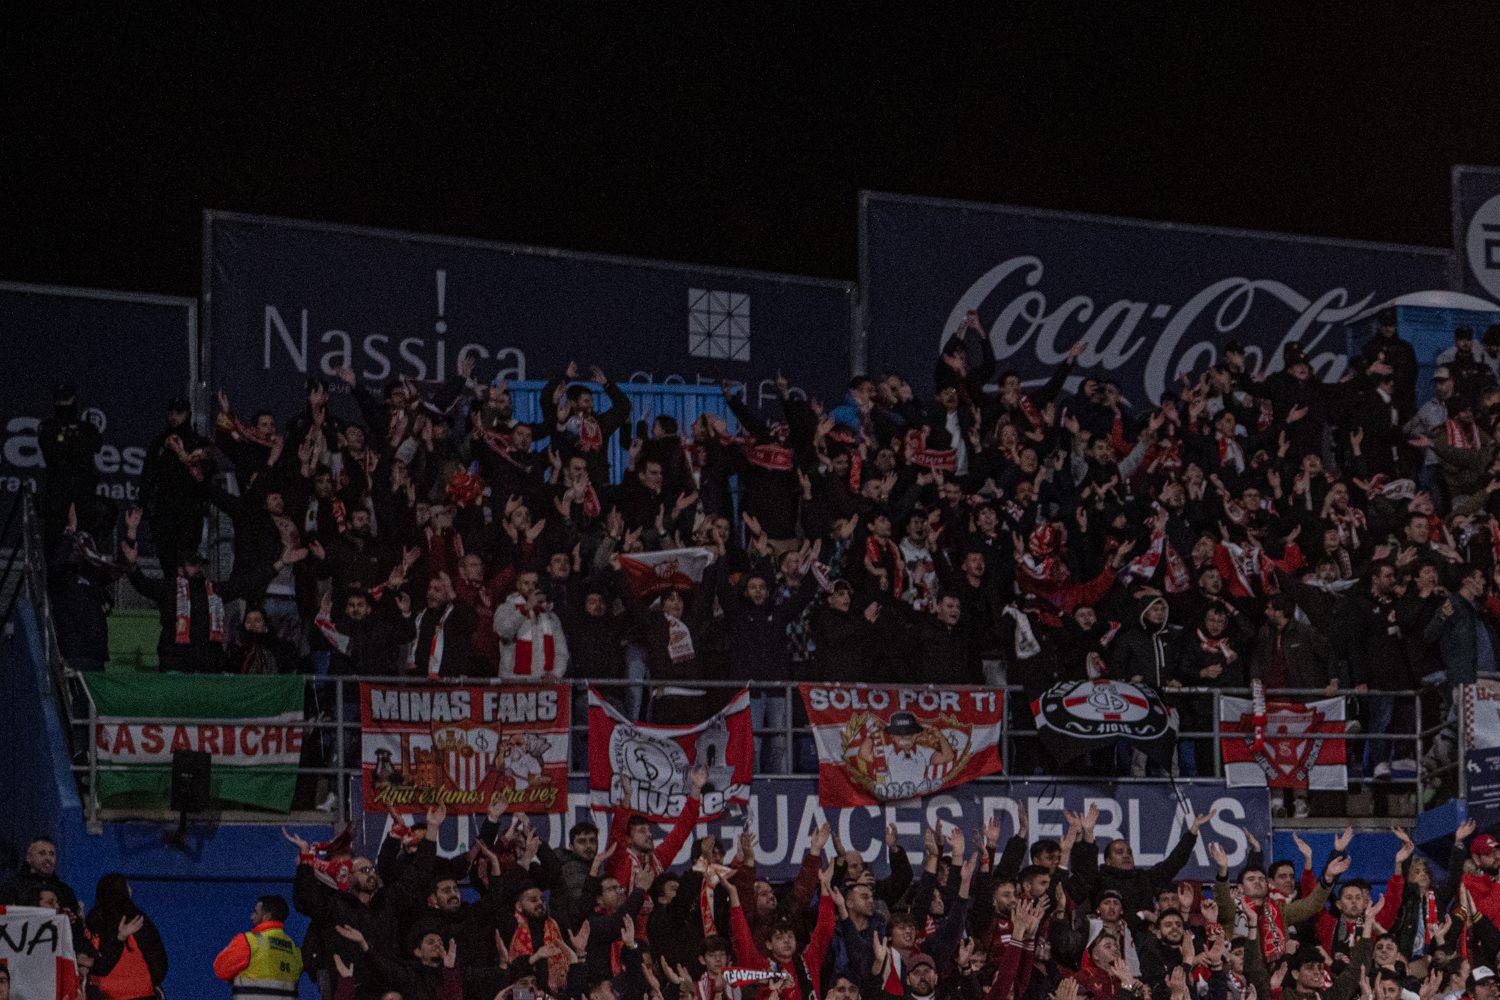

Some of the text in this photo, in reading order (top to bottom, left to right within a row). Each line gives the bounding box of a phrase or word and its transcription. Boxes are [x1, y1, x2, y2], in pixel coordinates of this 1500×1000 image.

[939, 254, 1376, 408] Coca-Cola
[369, 688, 559, 723] MINAS FANS
[809, 687, 997, 713] SOLO POR TI
[1088, 797, 1246, 869] BLAS
